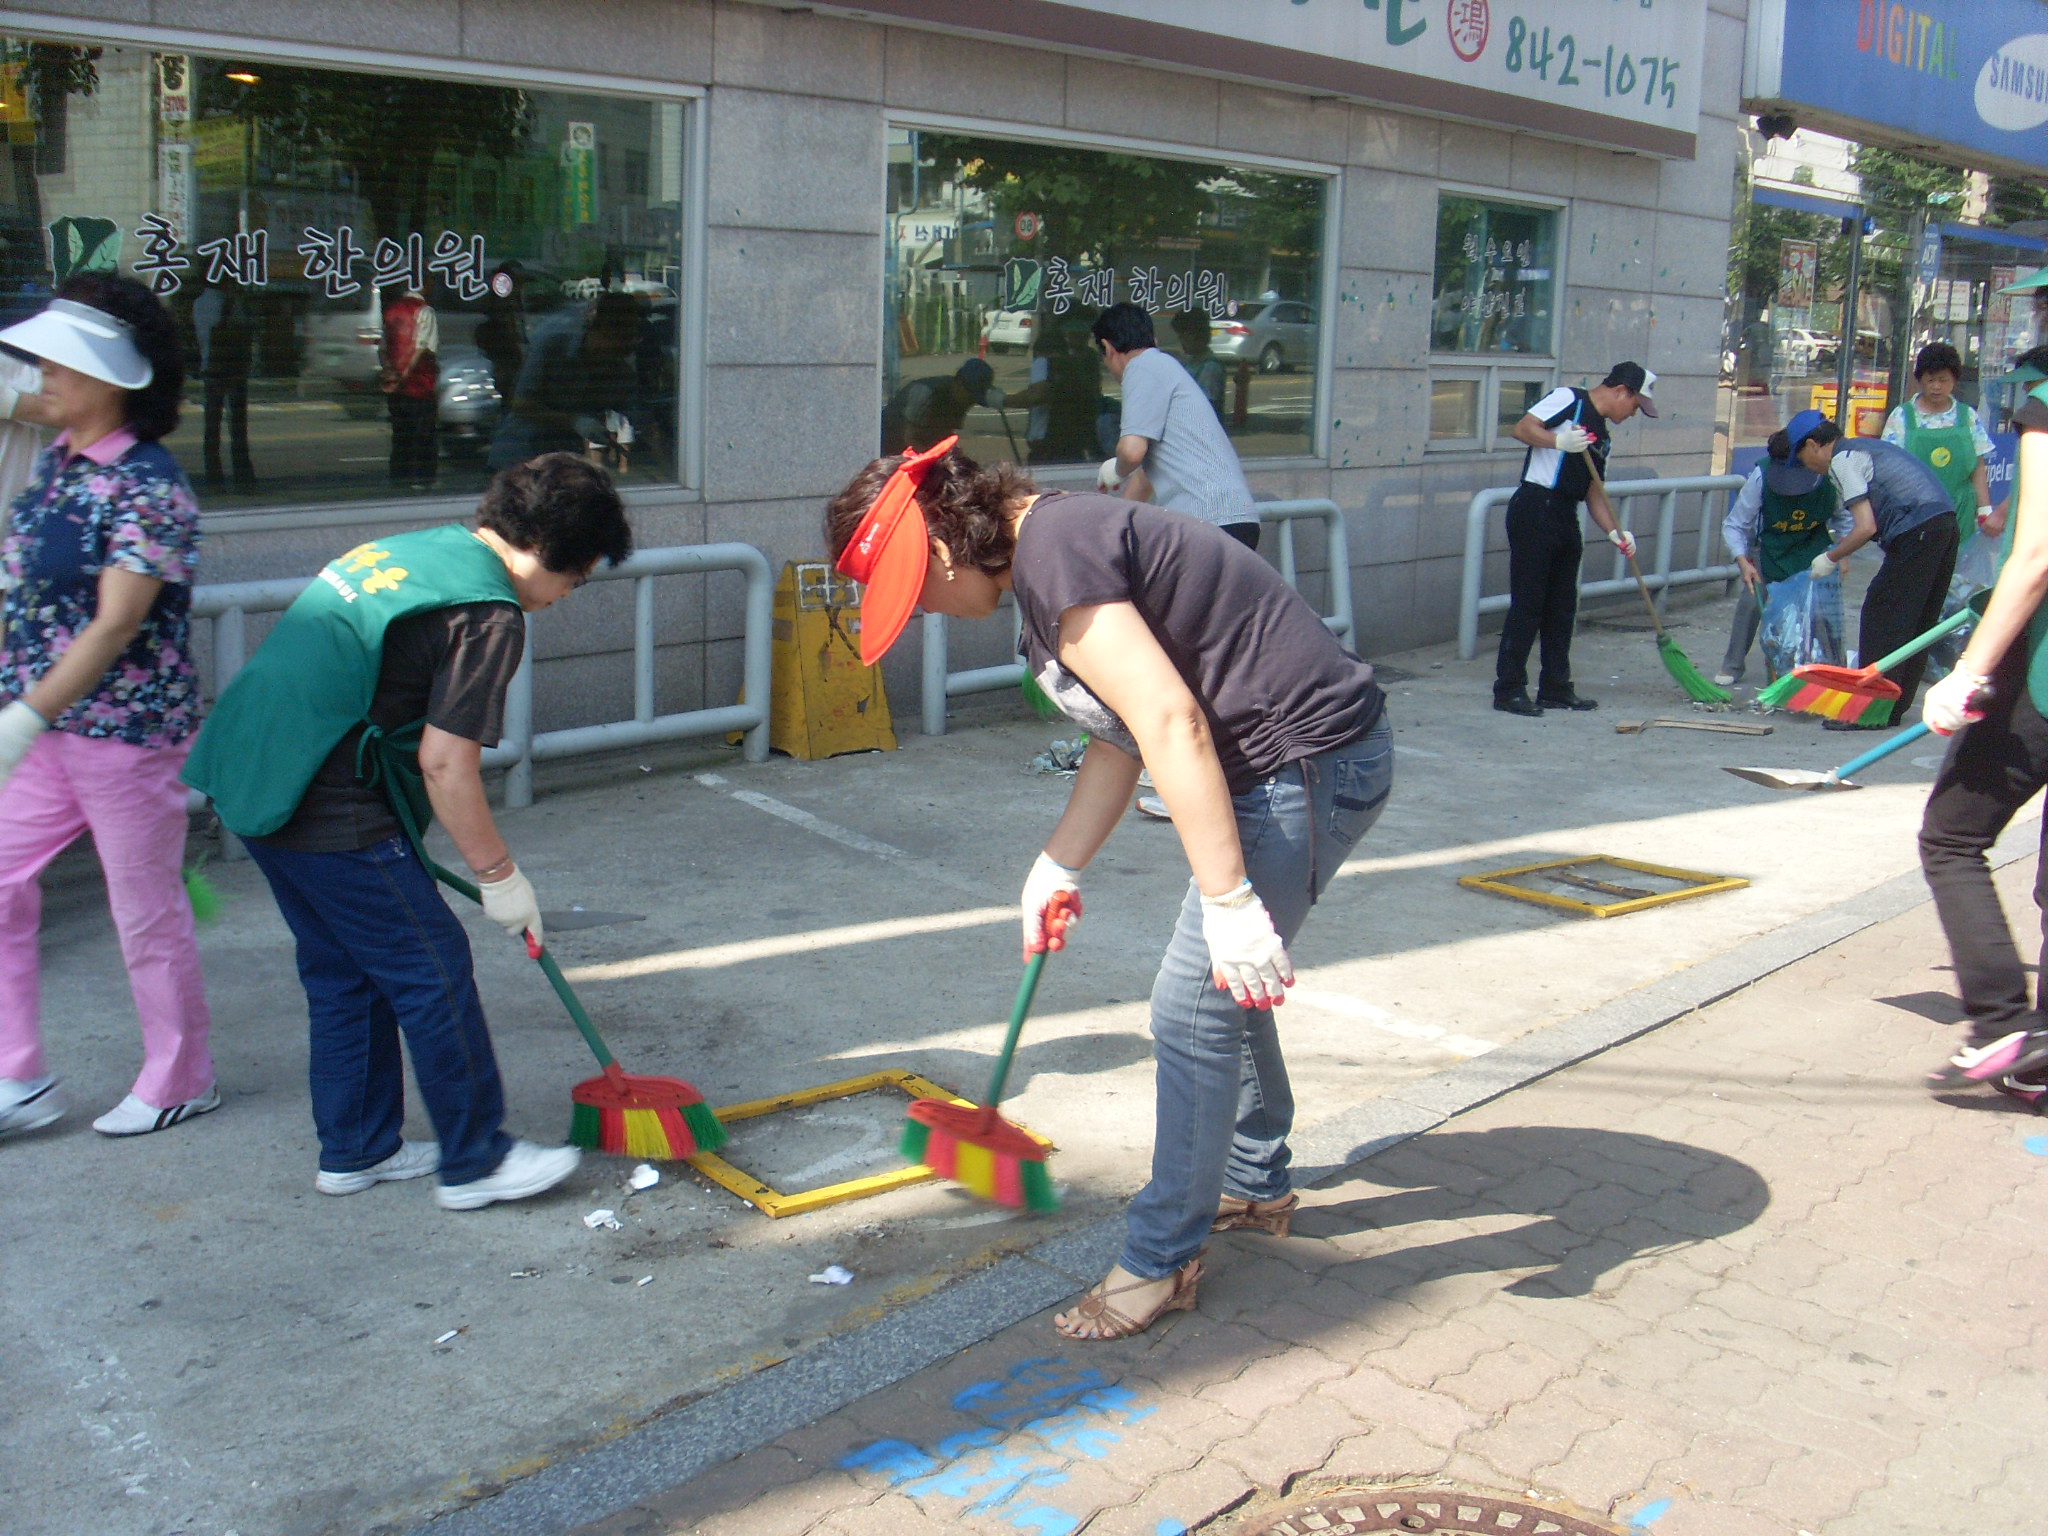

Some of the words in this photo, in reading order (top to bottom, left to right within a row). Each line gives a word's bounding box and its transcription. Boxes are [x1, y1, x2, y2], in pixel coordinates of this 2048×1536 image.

[1505, 15, 1680, 109] 842-1075
[1857, 0, 1959, 80] DIGITAL
[1990, 52, 2048, 104] SAMSU
[297, 225, 490, 300] 한의원
[1129, 266, 1225, 320] 한의원
[1985, 457, 2006, 488] ipel
